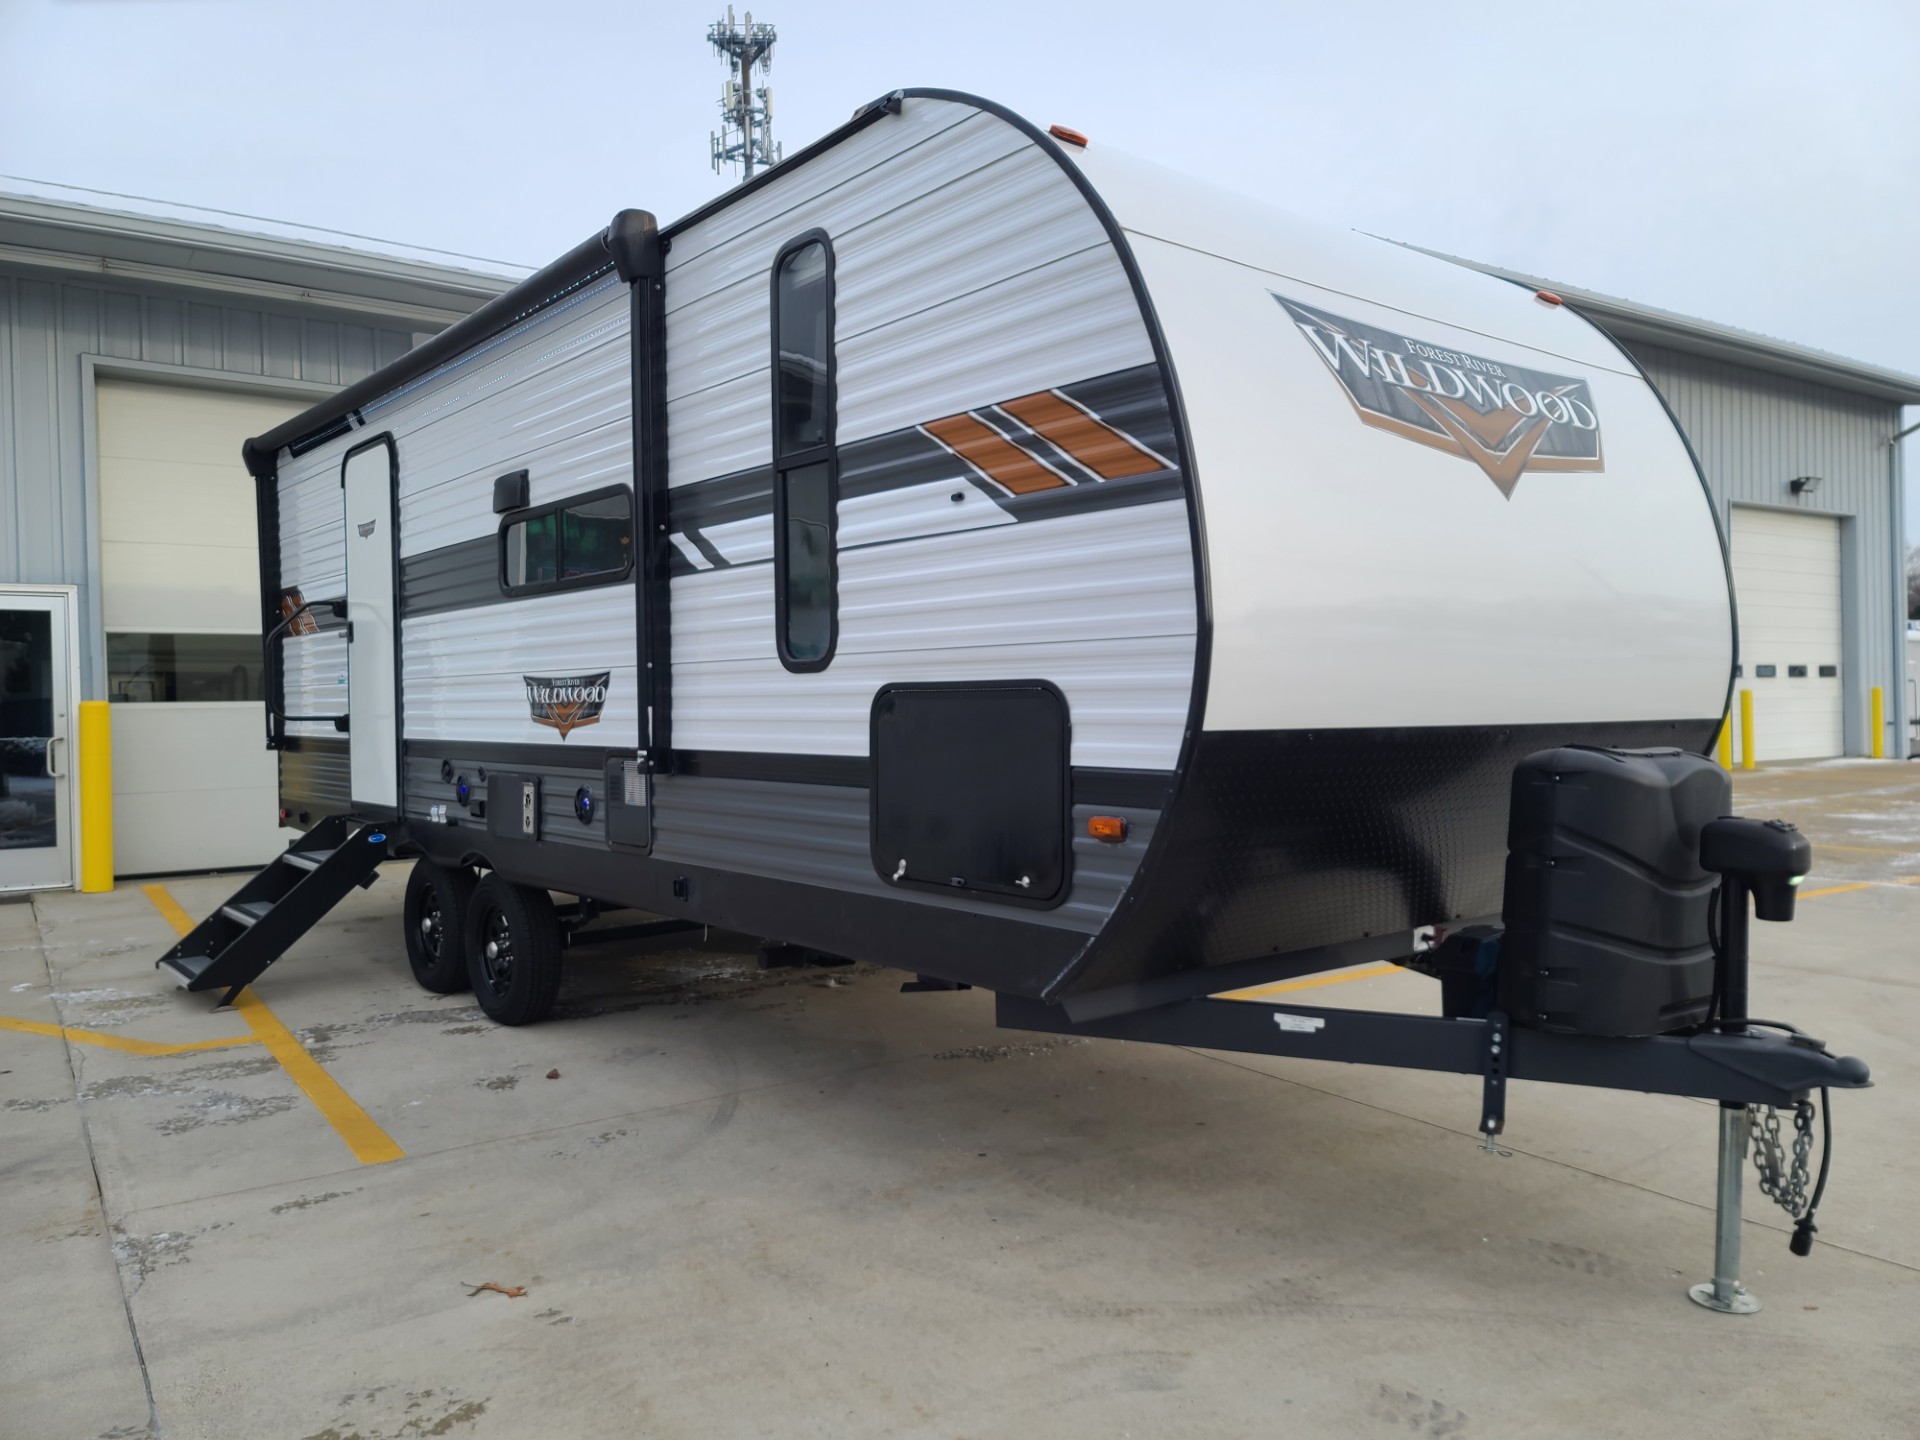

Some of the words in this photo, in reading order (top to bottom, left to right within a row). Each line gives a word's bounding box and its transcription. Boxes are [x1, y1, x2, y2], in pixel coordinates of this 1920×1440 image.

[1294, 320, 1598, 431] WILDWOOD
[1403, 338, 1462, 368] FOREST
[1461, 352, 1507, 378] RIVER
[527, 685, 606, 704] WILDWOOD
